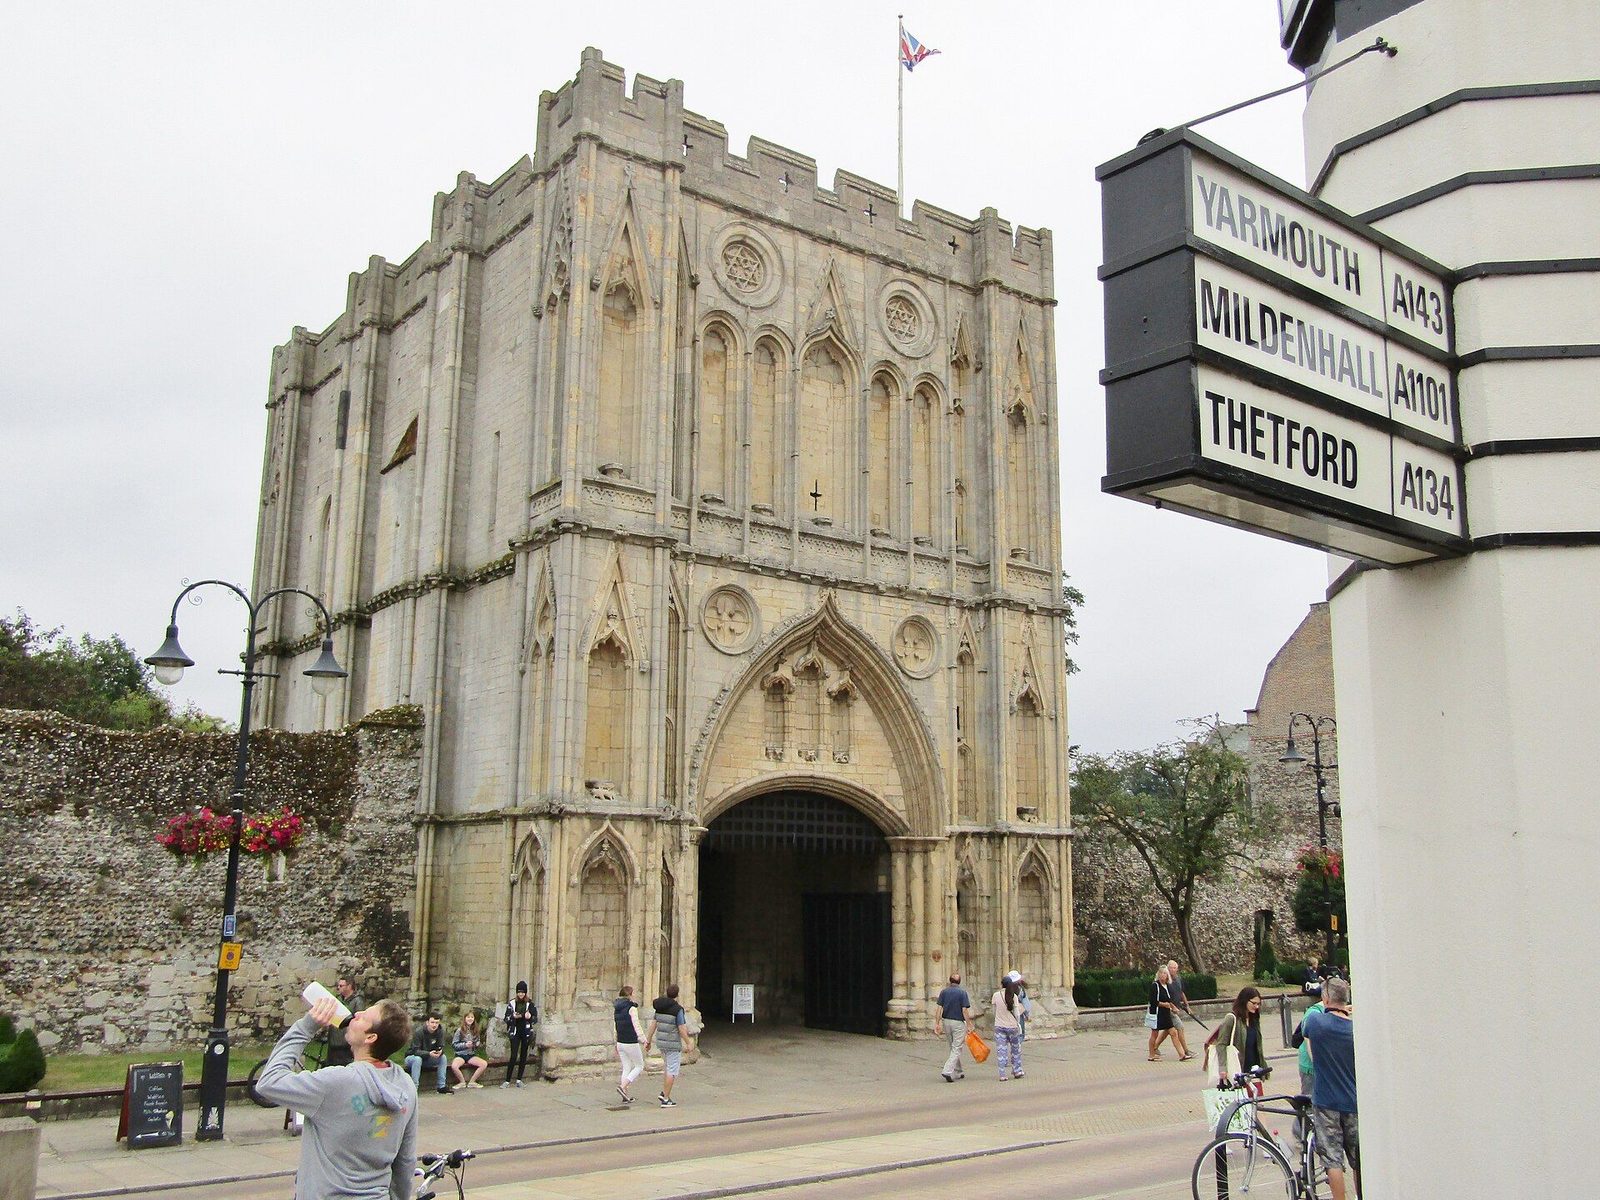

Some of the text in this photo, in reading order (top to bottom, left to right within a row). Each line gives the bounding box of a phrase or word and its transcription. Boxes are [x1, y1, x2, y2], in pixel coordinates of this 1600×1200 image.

[1197, 174, 1445, 336] YARMOUTH A143
[1200, 278, 1450, 426] MILDENHALL A1101
[1205, 389, 1455, 521] THETFORD A134
